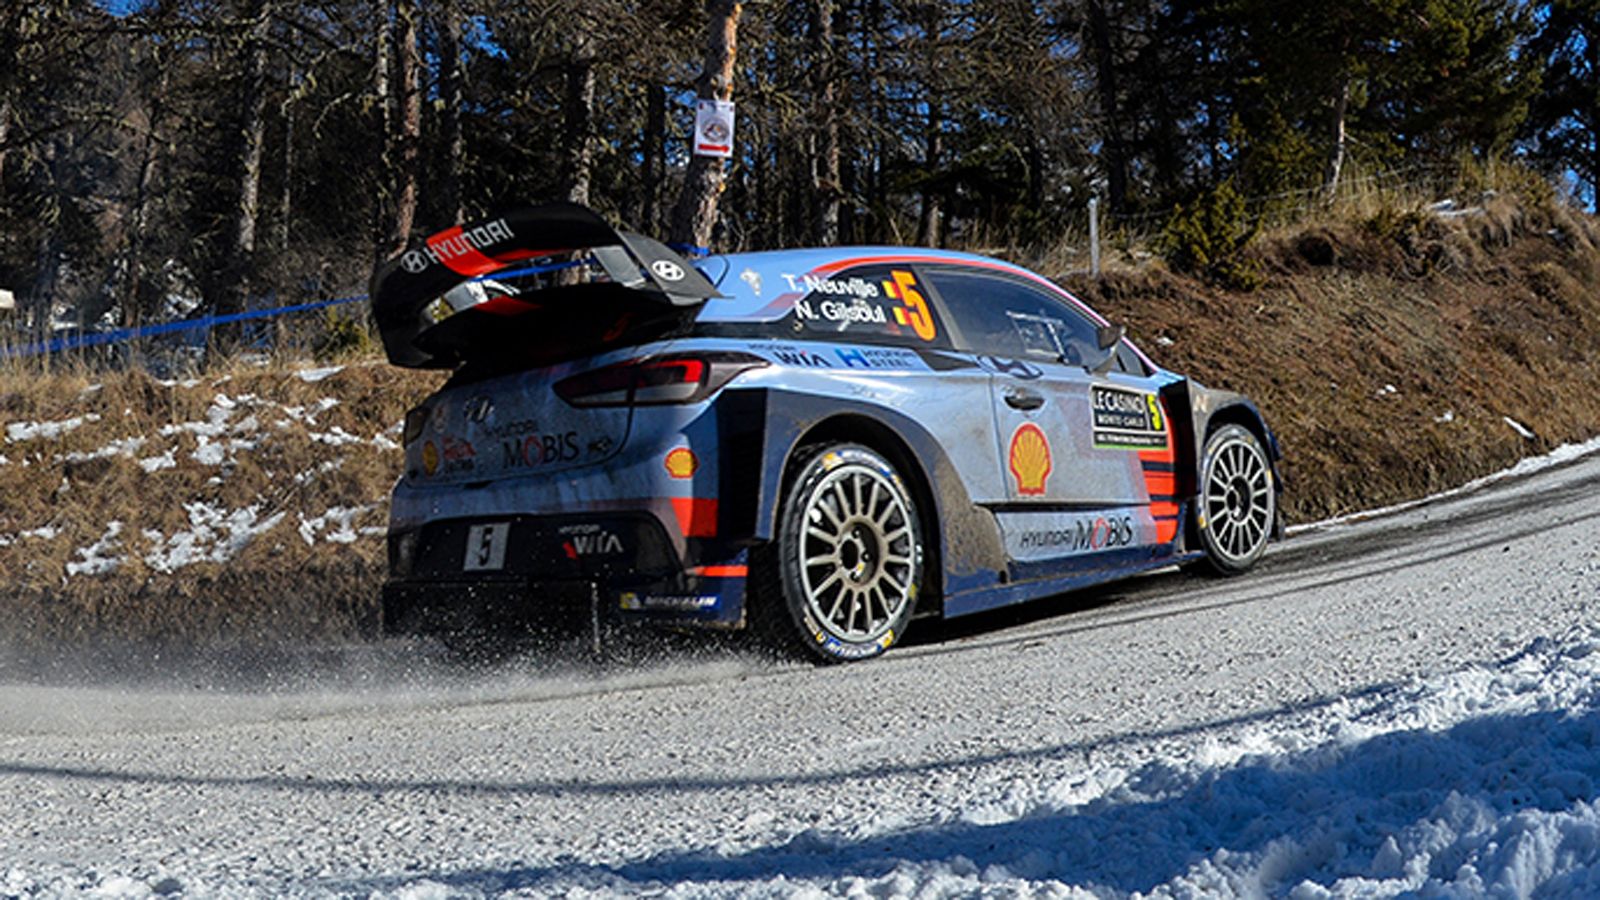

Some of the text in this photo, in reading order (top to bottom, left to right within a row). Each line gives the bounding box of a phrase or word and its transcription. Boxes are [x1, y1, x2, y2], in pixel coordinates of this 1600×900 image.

[423, 218, 515, 265] HYUNDAI
[781, 273, 879, 298] T. Neuville
[795, 300, 887, 323] N. Gilsoul
[890, 269, 937, 341] 5
[1105, 391, 1146, 414] CASINO
[1147, 394, 1162, 431] 5
[503, 432, 580, 469] MOBIS
[479, 527, 494, 567] 5
[573, 531, 624, 554] WIA
[1073, 516, 1133, 550] MOBIS
